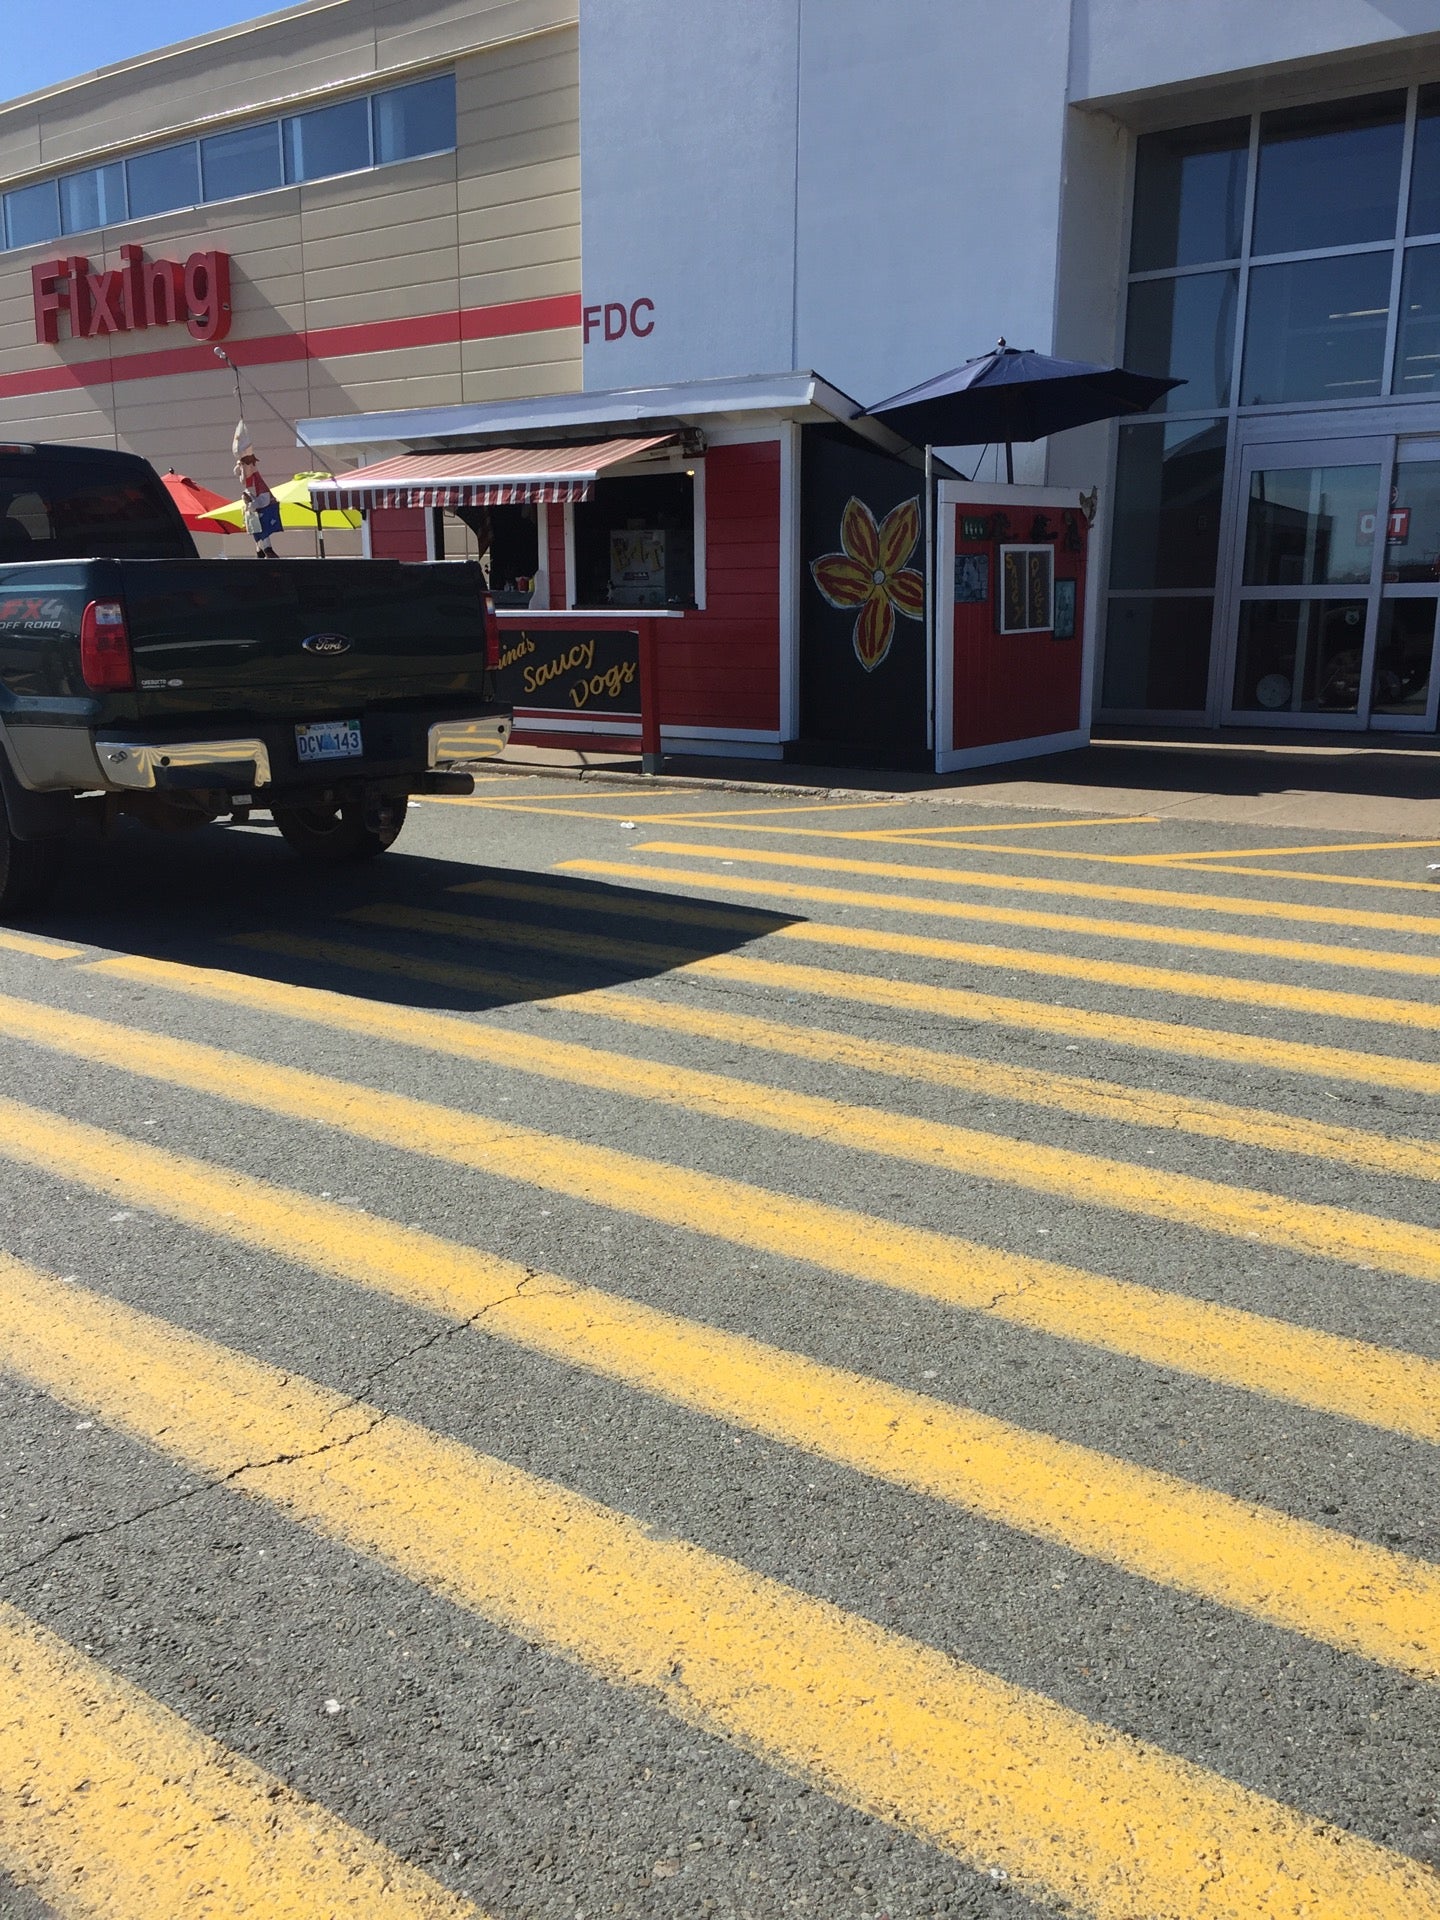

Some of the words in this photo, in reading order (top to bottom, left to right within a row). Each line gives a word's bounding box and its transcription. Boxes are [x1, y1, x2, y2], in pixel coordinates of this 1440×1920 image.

[32, 244, 232, 344] Fixing
[583, 297, 655, 344] FDC
[1361, 513, 1406, 533] OT
[0, 598, 64, 620] FX4
[24, 621, 61, 629] ROAD
[497, 631, 535, 670] ina's
[523, 639, 595, 693] Saucy
[569, 661, 637, 707] Dogs
[299, 734, 324, 754] DCV
[333, 731, 359, 750] 143
